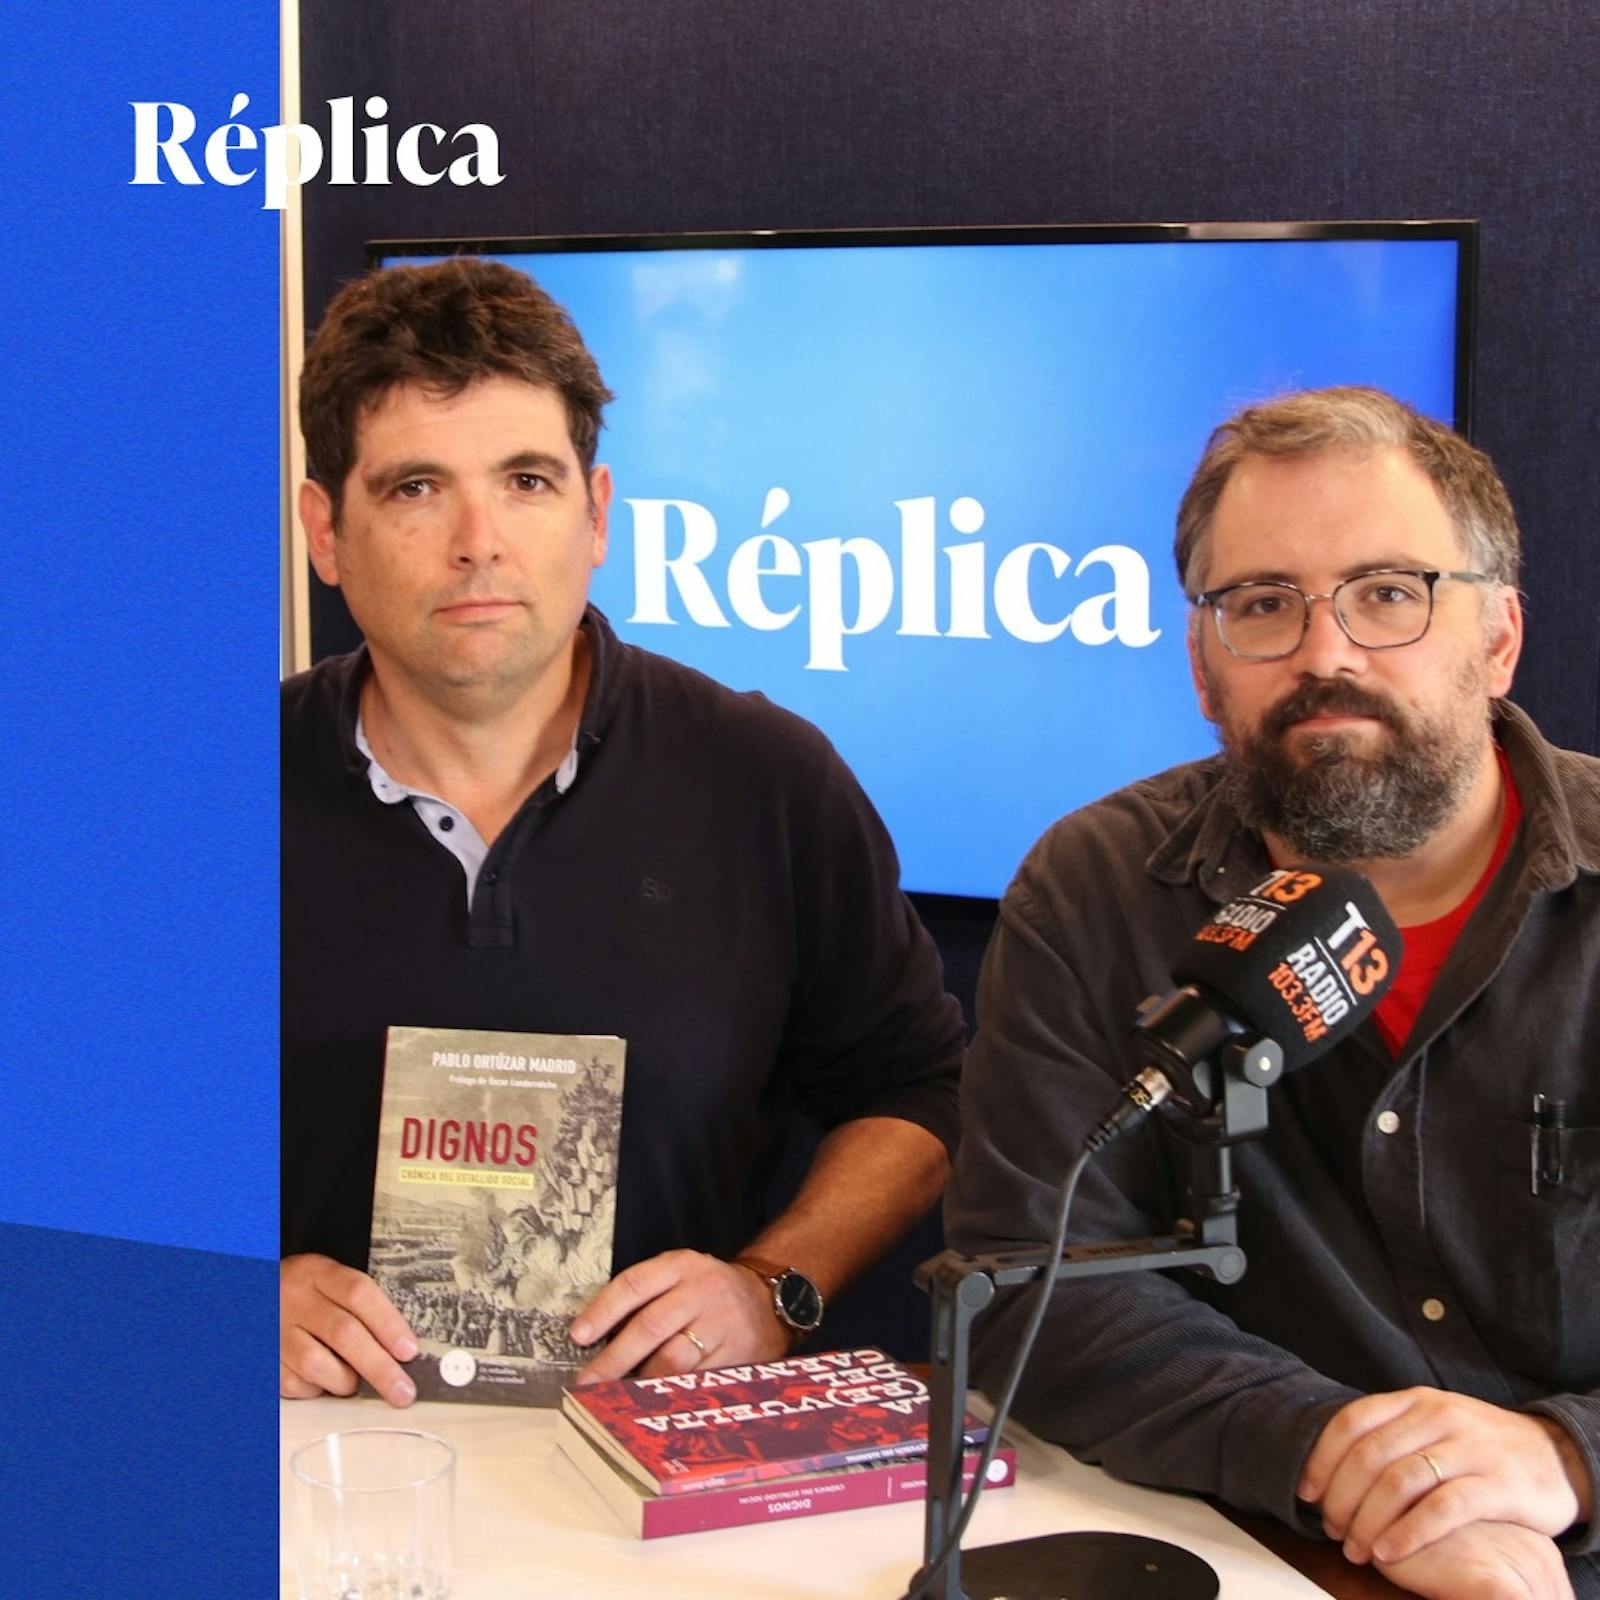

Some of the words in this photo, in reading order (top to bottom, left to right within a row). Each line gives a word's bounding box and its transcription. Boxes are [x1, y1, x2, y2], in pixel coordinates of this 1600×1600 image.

[623, 487, 1162, 671] Réplica
[1249, 869, 1323, 903] T13
[1327, 901, 1389, 995] T13
[1286, 942, 1350, 1026] RADIO
[432, 1051, 470, 1069] PABLO
[473, 1053, 526, 1071] ORTÚZAR
[529, 1057, 577, 1075] MADRID
[400, 1117, 539, 1167] DIGNOS
[634, 1349, 885, 1394] CARNAVAL
[809, 1362, 909, 1388] DEL
[767, 1498, 812, 1514] DIGNOS
